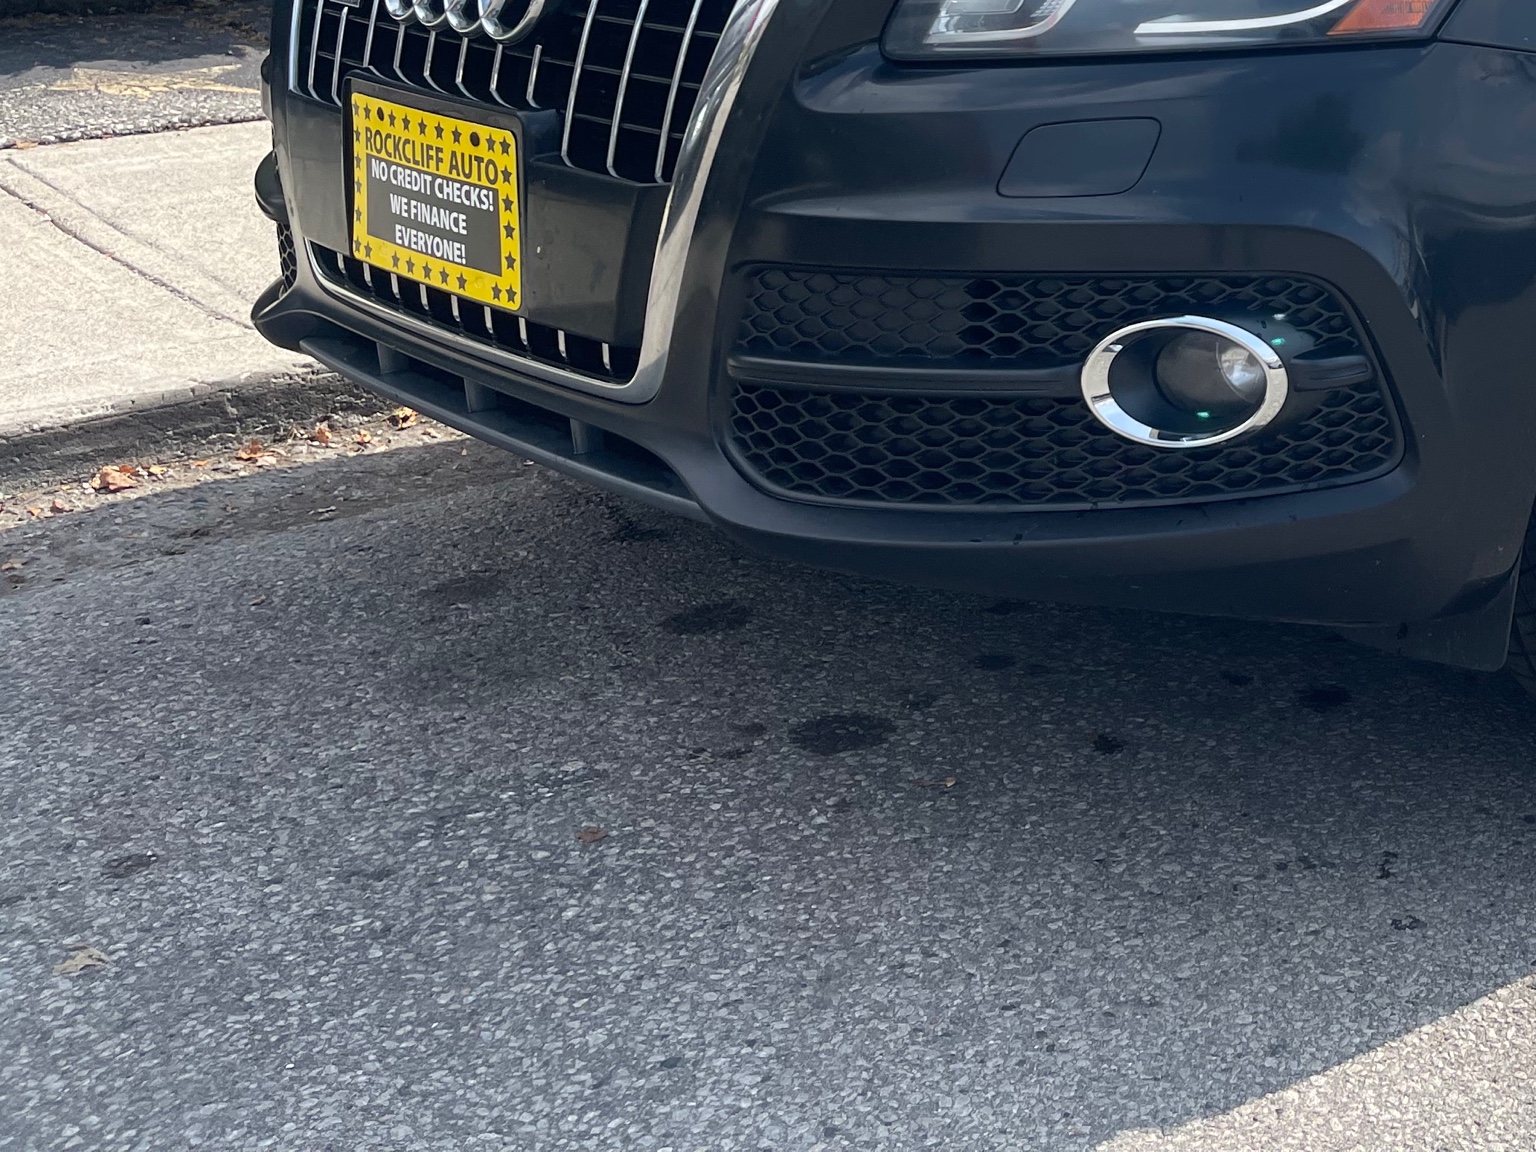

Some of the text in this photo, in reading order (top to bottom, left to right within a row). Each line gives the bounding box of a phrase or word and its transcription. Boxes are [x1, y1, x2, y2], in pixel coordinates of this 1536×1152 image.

[365, 126, 499, 186] ROCKCLIFF AUTO
[371, 158, 494, 212] NO CREDIT CHECKS!
[389, 193, 468, 235] WE FINANCE
[395, 224, 466, 265] EVERYONE!
